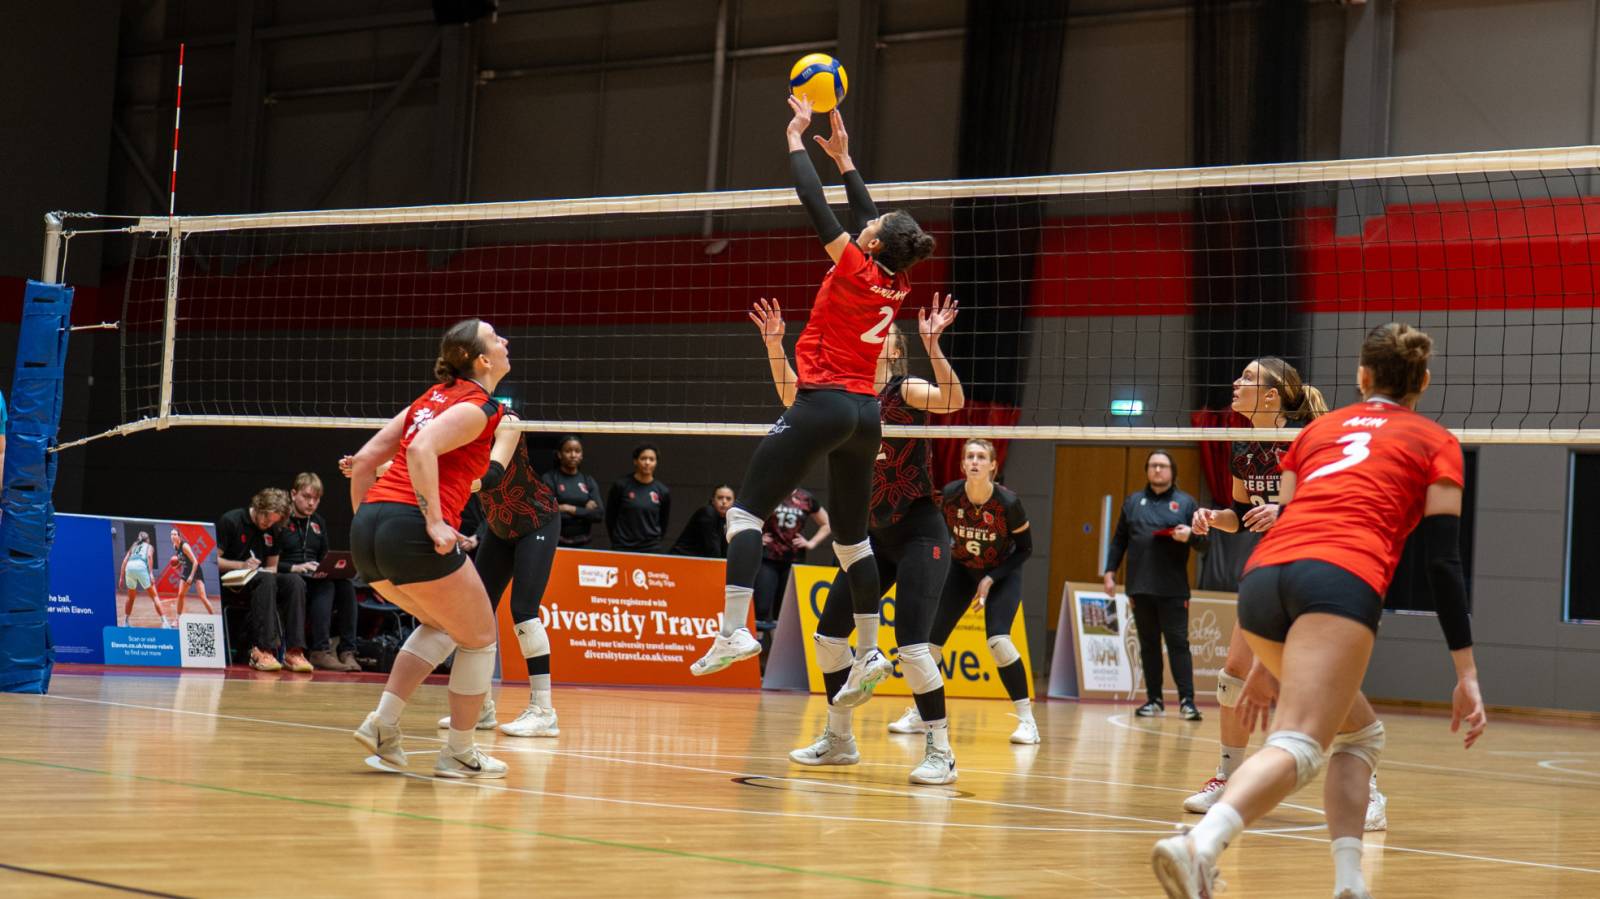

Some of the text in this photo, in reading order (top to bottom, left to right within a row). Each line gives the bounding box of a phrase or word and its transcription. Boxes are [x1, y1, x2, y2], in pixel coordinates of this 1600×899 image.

[860, 306, 894, 344] 2
[1342, 416, 1388, 428] AKIN
[1304, 432, 1372, 482] 3
[776, 512, 797, 529] 13
[953, 526, 997, 541] REBELS
[965, 540, 982, 557] 6
[647, 571, 669, 580] Diversity
[648, 579, 663, 587] Study
[58, 594, 71, 602] ball.
[607, 598, 620, 606] you
[620, 597, 652, 607] registered
[652, 599, 668, 607] with
[56, 605, 70, 613] with
[71, 605, 94, 615] Elavon.
[569, 638, 587, 646] Book
[613, 640, 645, 650] University
[646, 642, 664, 650] travel
[685, 643, 696, 651] via
[584, 649, 684, 663] diversitytravel.co.uk/essex
